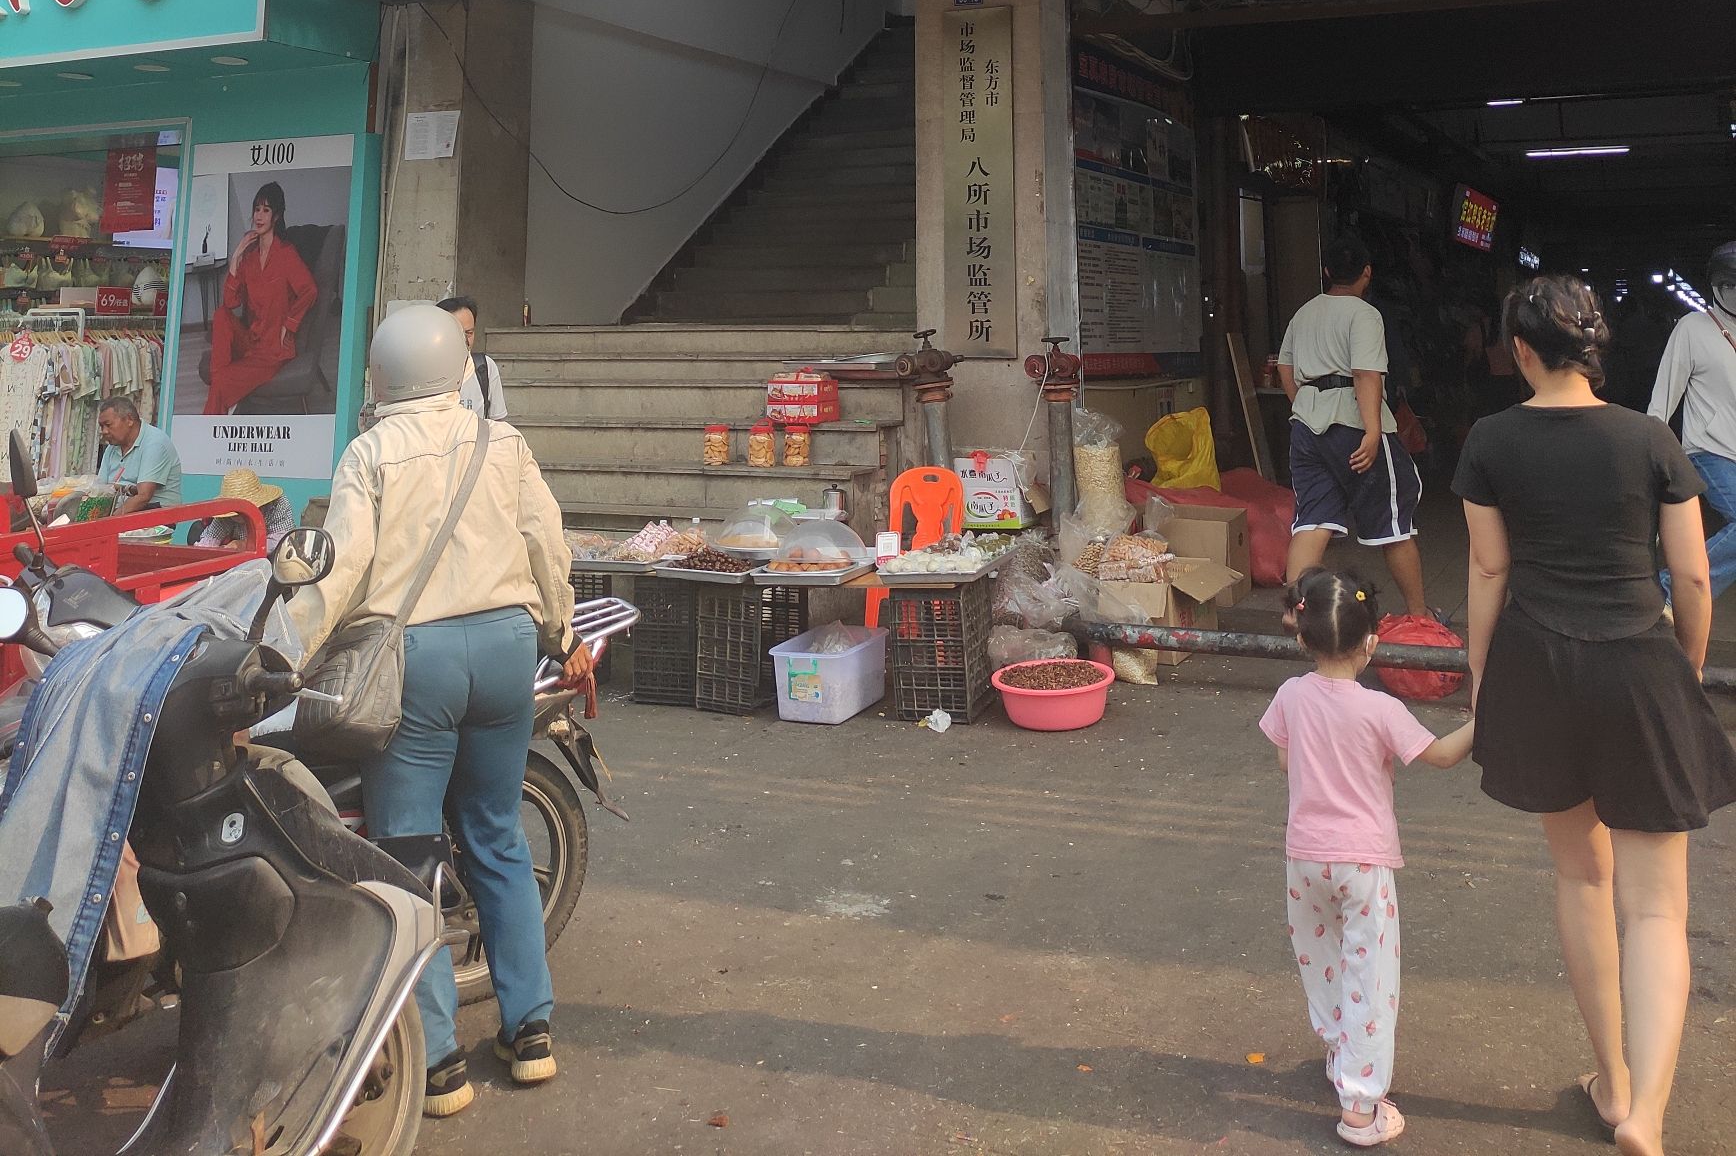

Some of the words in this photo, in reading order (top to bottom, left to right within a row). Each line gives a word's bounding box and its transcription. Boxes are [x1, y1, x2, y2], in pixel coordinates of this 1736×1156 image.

[959, 21, 976, 143] 市场监督管理局
[984, 59, 1000, 107] 东方市
[250, 142, 295, 166] 女人100
[966, 156, 993, 343] 八所市场监管所
[212, 425, 291, 440] UNDERWEAR
[228, 442, 248, 452] LIFE
[251, 442, 274, 453] HALL
